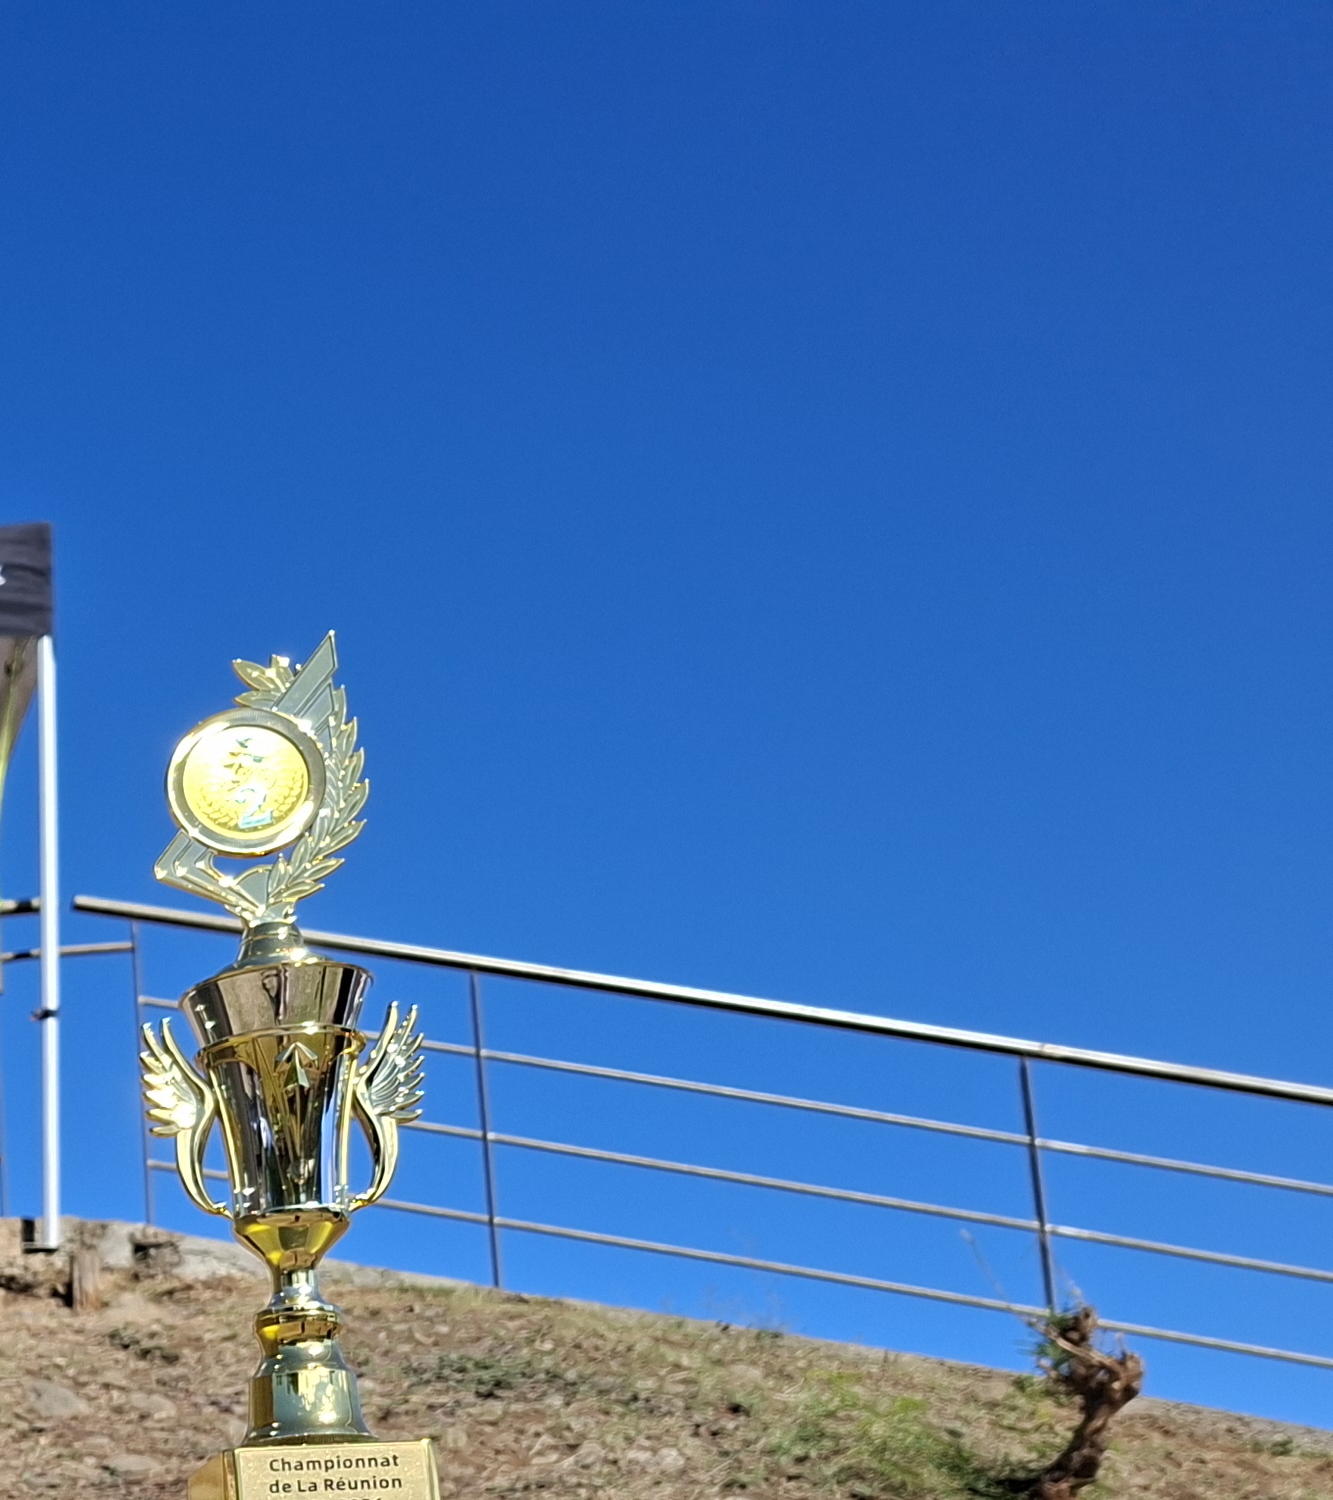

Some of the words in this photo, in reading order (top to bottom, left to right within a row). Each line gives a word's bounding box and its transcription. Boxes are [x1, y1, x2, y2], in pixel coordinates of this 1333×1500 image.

[269, 1454, 400, 1473] Championnat
[269, 1480, 292, 1494] de
[297, 1479, 318, 1493] La
[324, 1475, 402, 1492] Réunion
